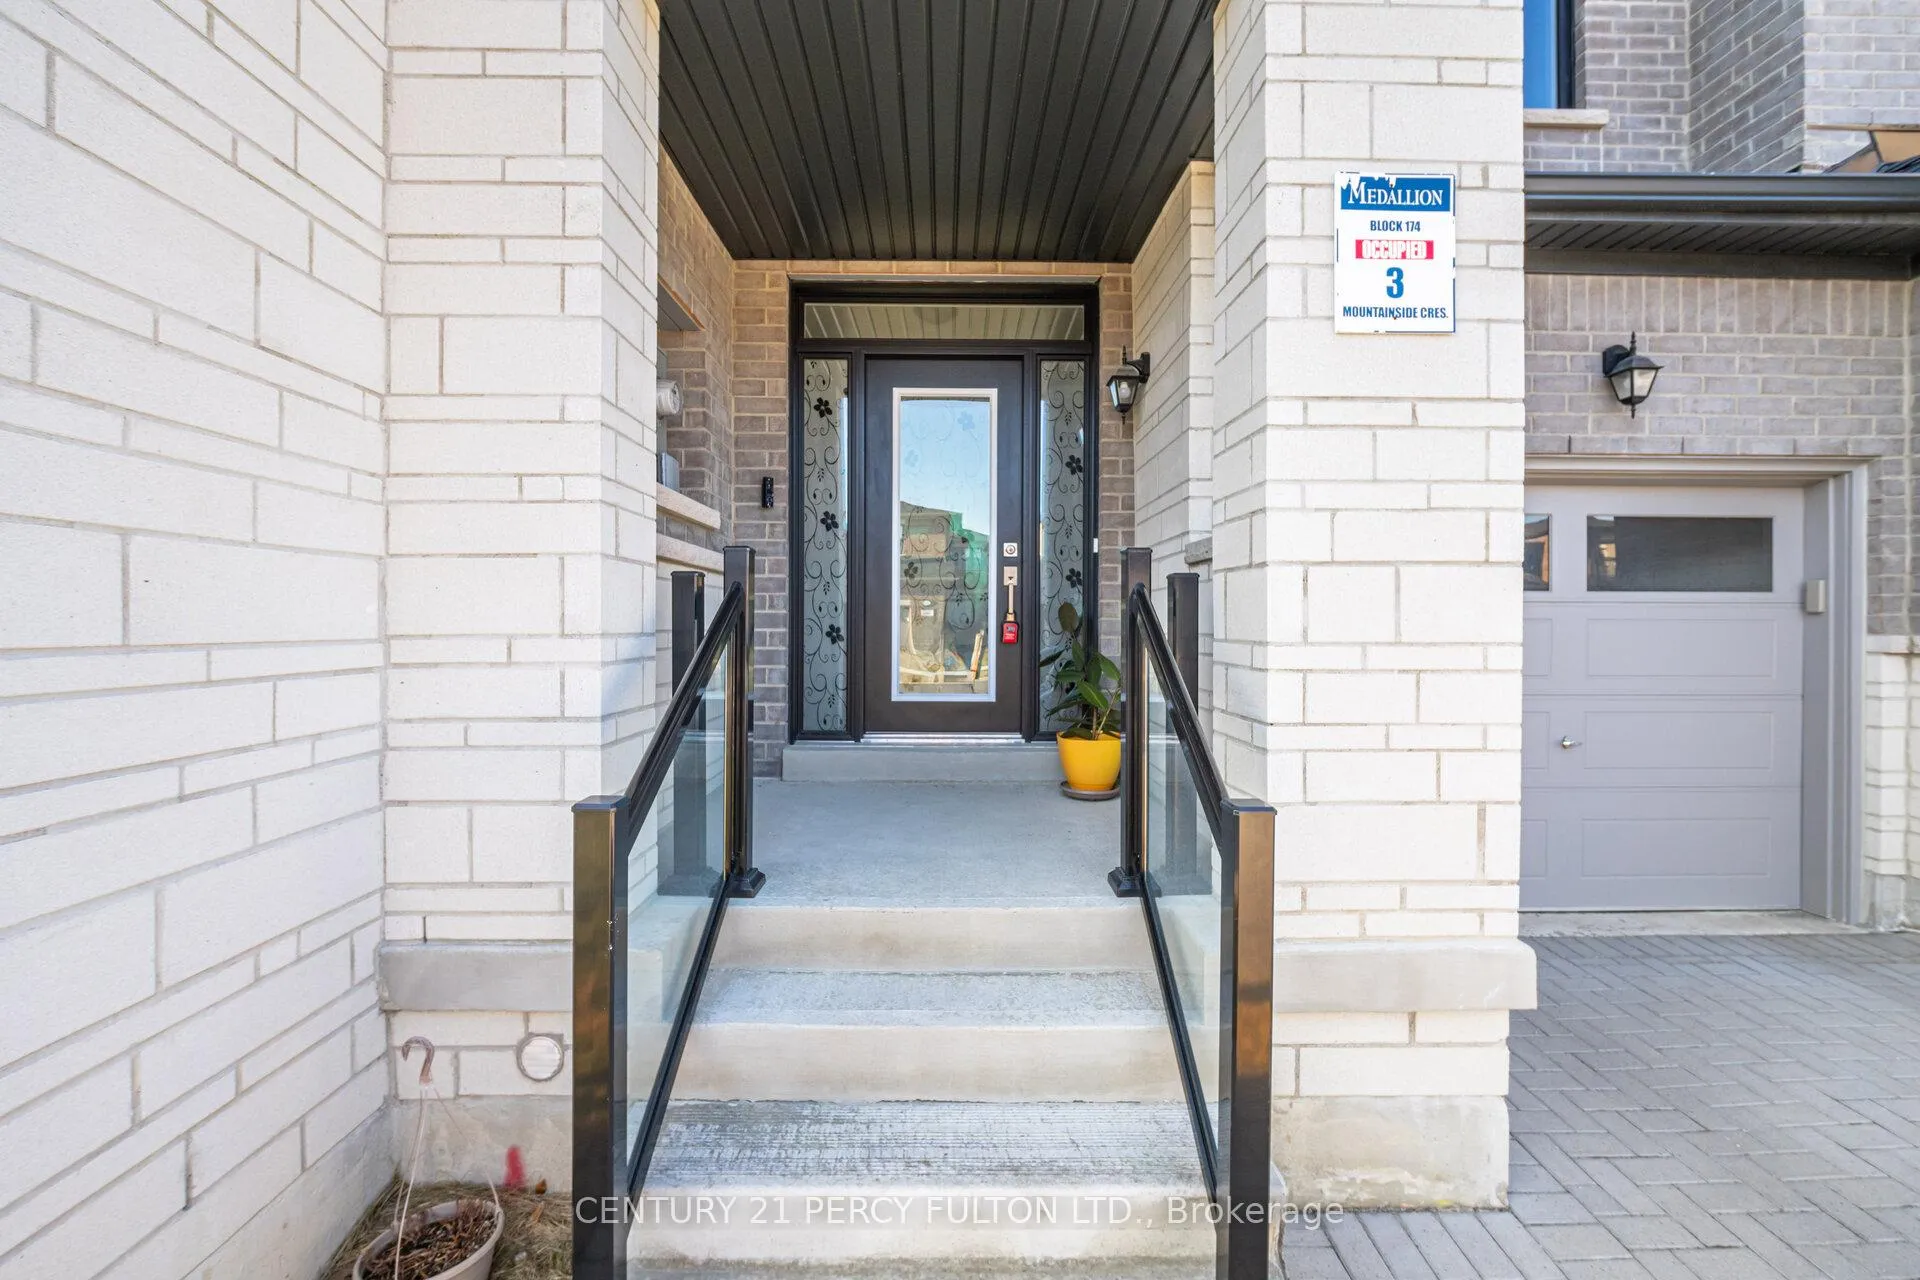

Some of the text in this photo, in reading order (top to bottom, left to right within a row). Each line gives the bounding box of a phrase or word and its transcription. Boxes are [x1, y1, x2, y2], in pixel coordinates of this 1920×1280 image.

[1348, 181, 1443, 206] MEDALLION
[1370, 220, 1421, 232] BLOCK 174
[1361, 240, 1427, 259] OCCUPIED
[1386, 266, 1404, 299] 3
[1342, 306, 1449, 319] MOUNTAINSIDE CRES.
